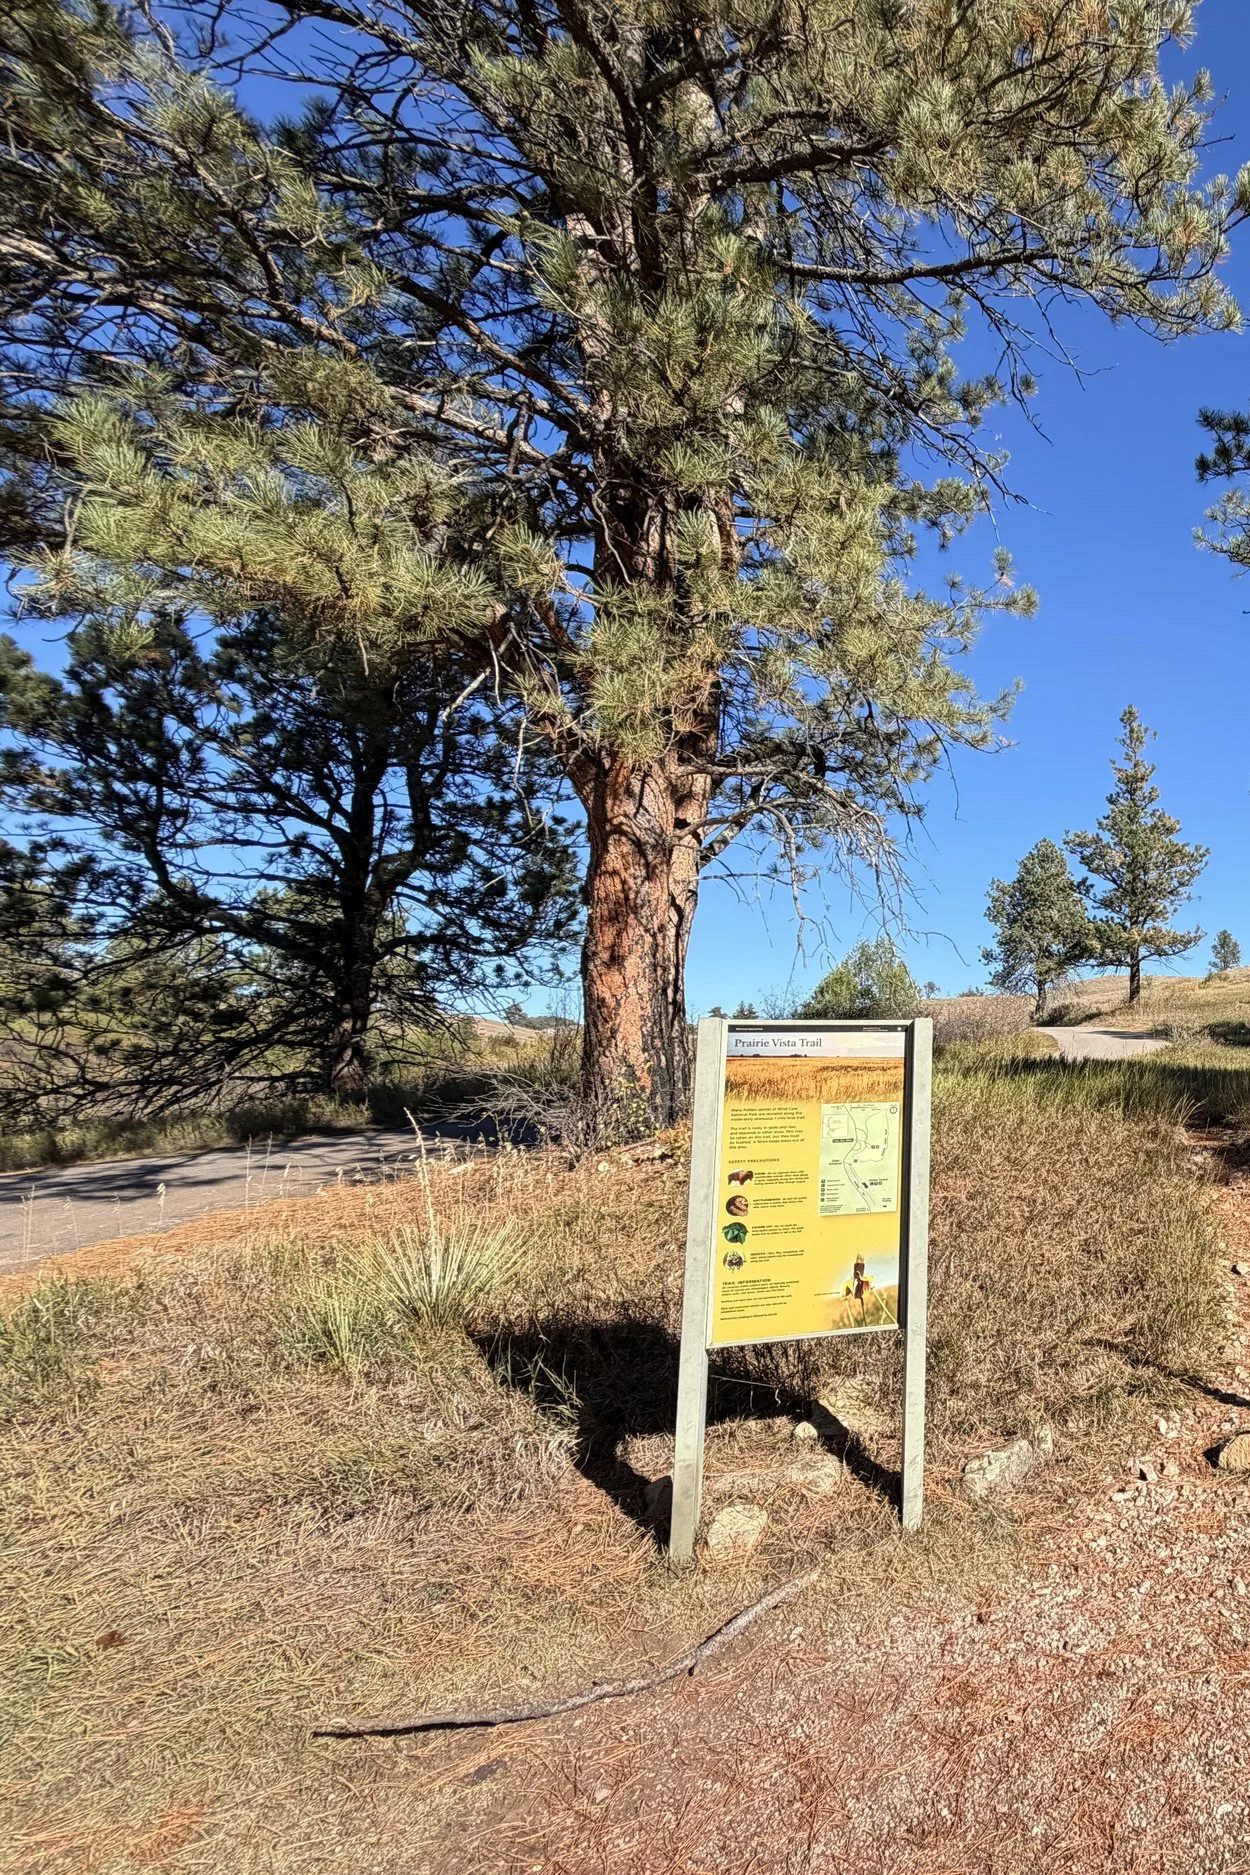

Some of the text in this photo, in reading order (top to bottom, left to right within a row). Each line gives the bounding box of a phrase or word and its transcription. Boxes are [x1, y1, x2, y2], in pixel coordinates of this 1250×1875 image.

[734, 1038, 822, 1048] Prairie Vista Trail
